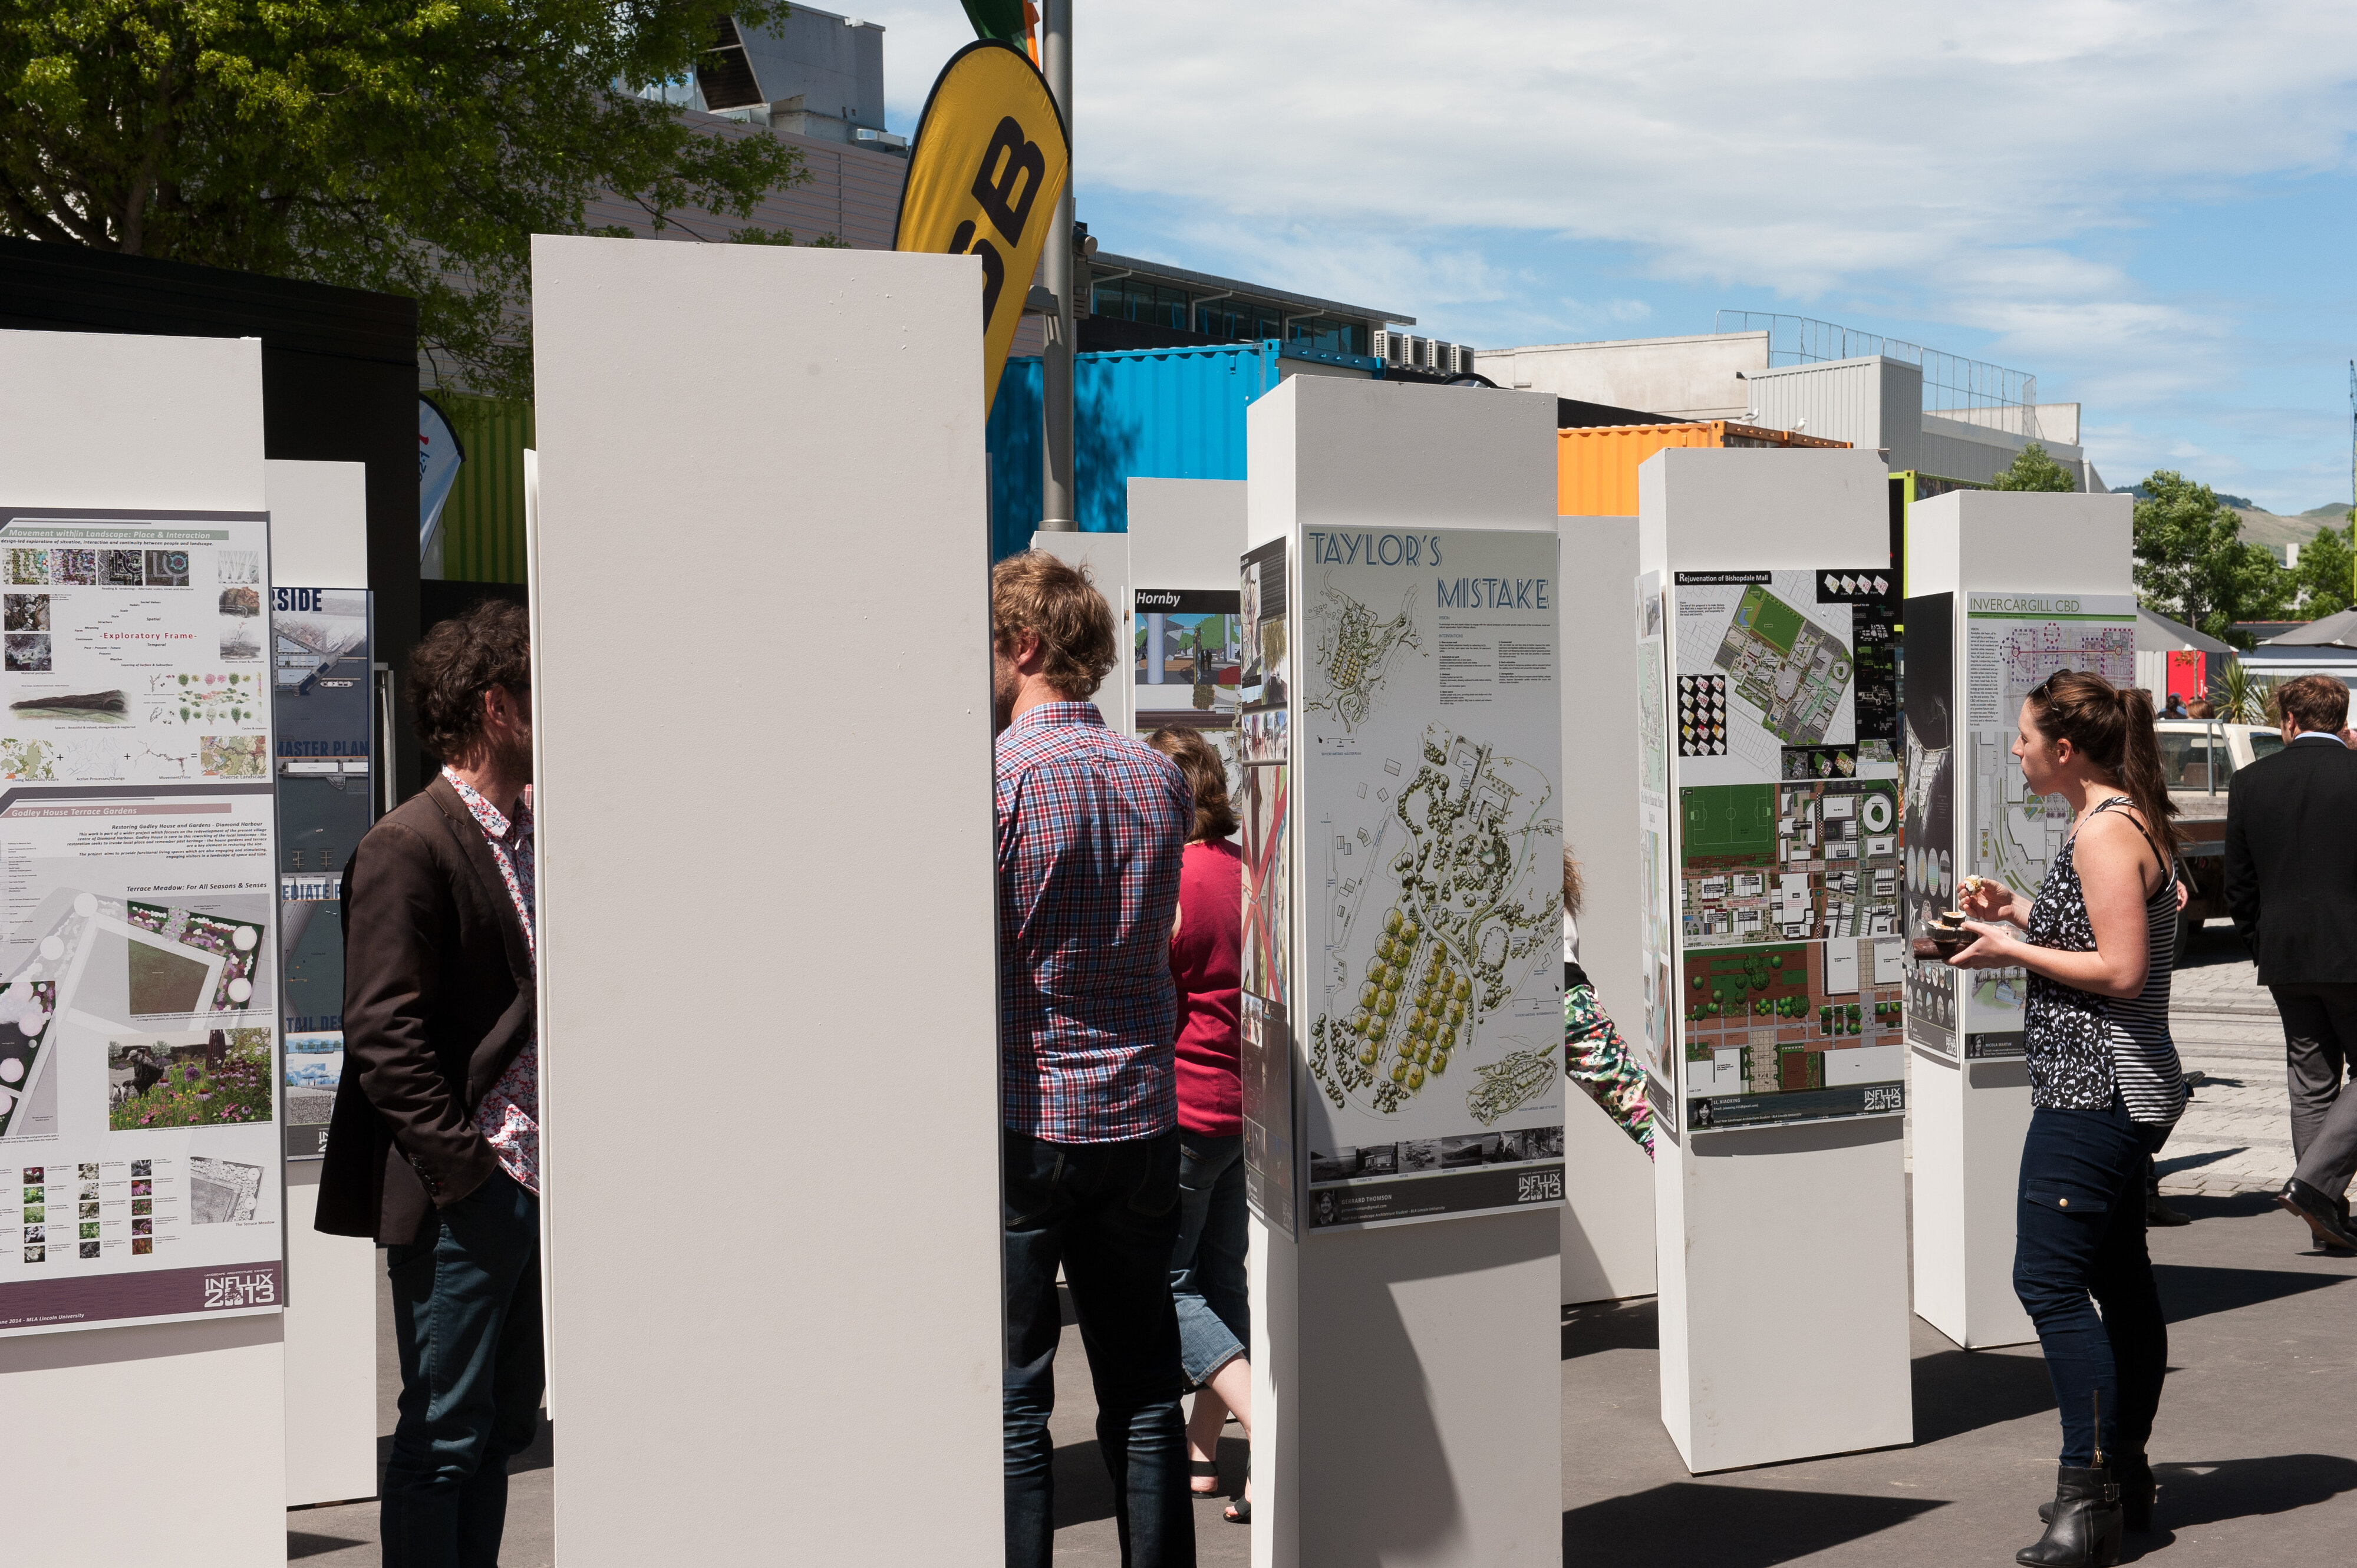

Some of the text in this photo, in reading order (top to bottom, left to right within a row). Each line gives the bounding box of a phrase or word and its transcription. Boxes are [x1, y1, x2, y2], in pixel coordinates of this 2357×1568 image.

[86, 530, 131, 539] Landscape:
[1308, 532, 1442, 567] TAYLOR'S
[1679, 573, 1717, 583] Rejuvenation
[1725, 575, 1755, 584] Bishopdale
[1136, 592, 1181, 607] Hornby
[1438, 577, 1550, 609] MISTAKE
[1970, 598, 2079, 612] INVERCARGILL CBD
[334, 741, 369, 757] PLAN
[1864, 1088, 1901, 1098] INFLUX
[1519, 1173, 1561, 1187] INFLUX
[205, 1273, 274, 1290] INFLUX
[204, 1285, 275, 1308] 2013
